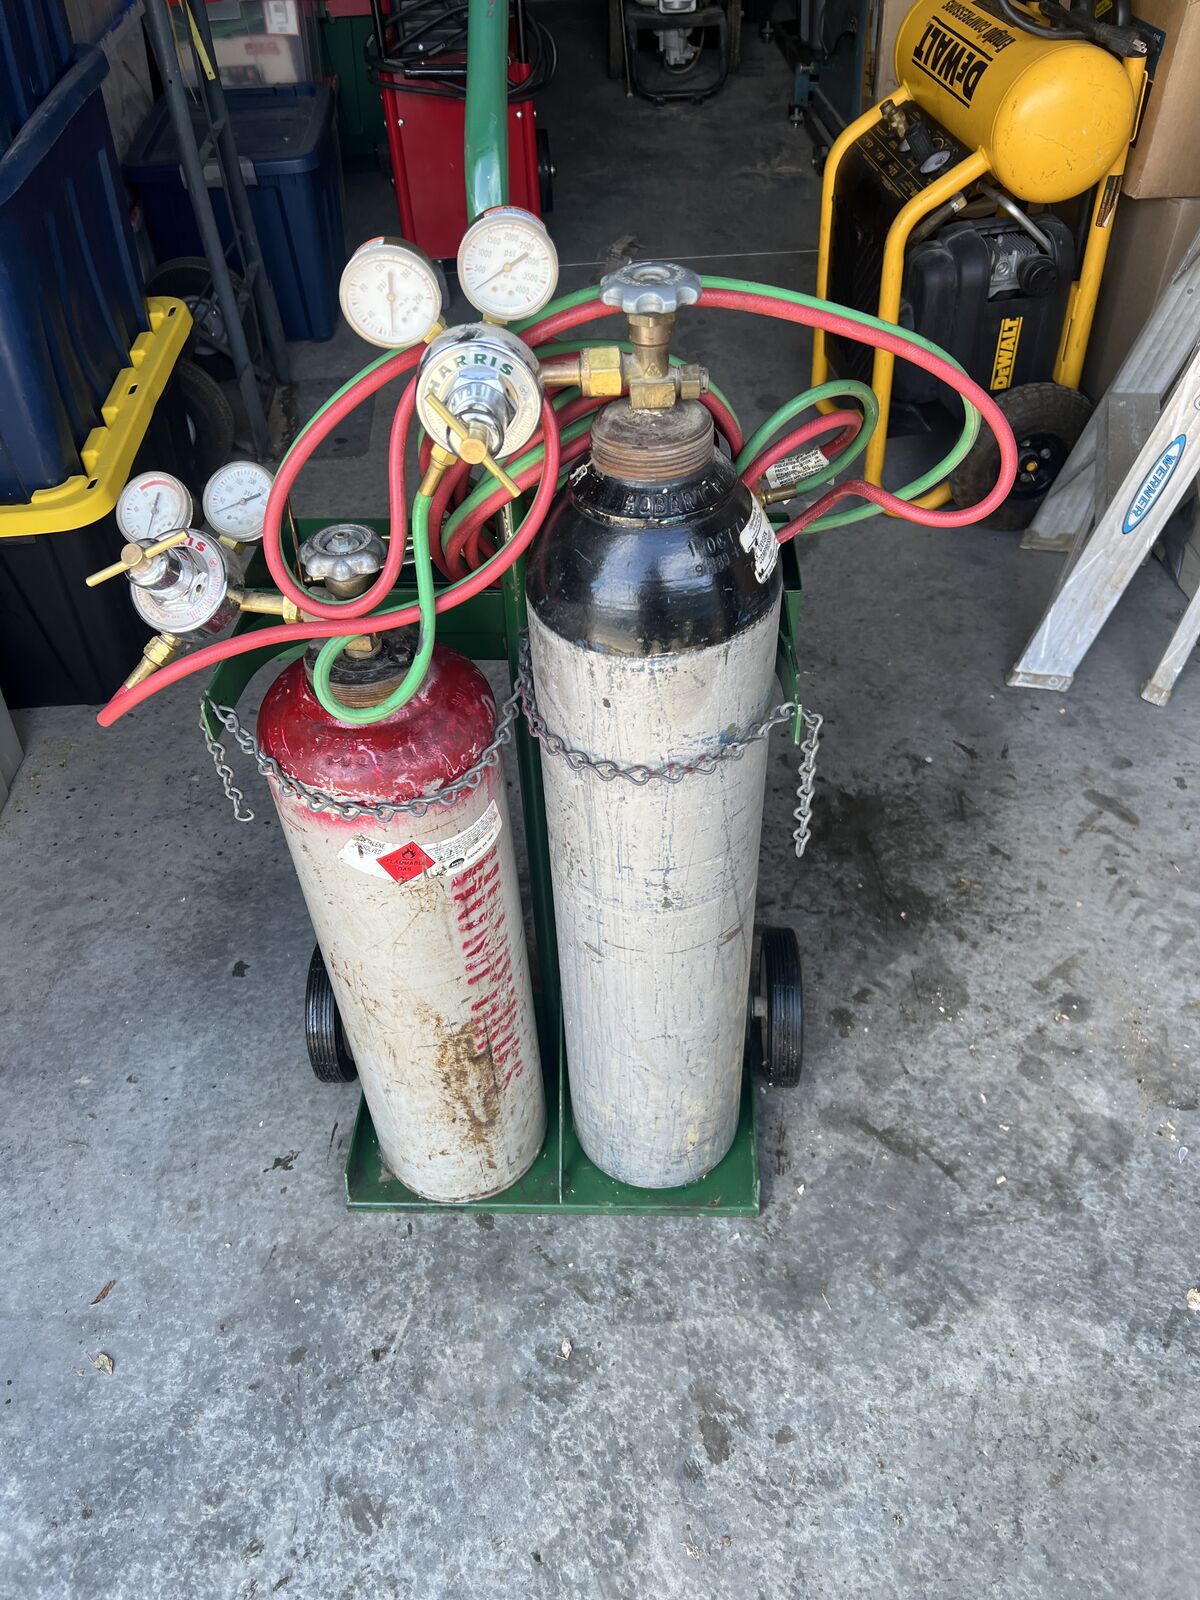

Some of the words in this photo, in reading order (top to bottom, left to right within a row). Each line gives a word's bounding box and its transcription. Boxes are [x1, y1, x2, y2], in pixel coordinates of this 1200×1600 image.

[941, 0, 992, 33] COMPRESSORS
[981, 27, 1016, 54] Emglo
[426, 353, 514, 393] HARRIS
[1132, 453, 1177, 519] WERNER
[386, 857, 427, 866] FLAMMABL
